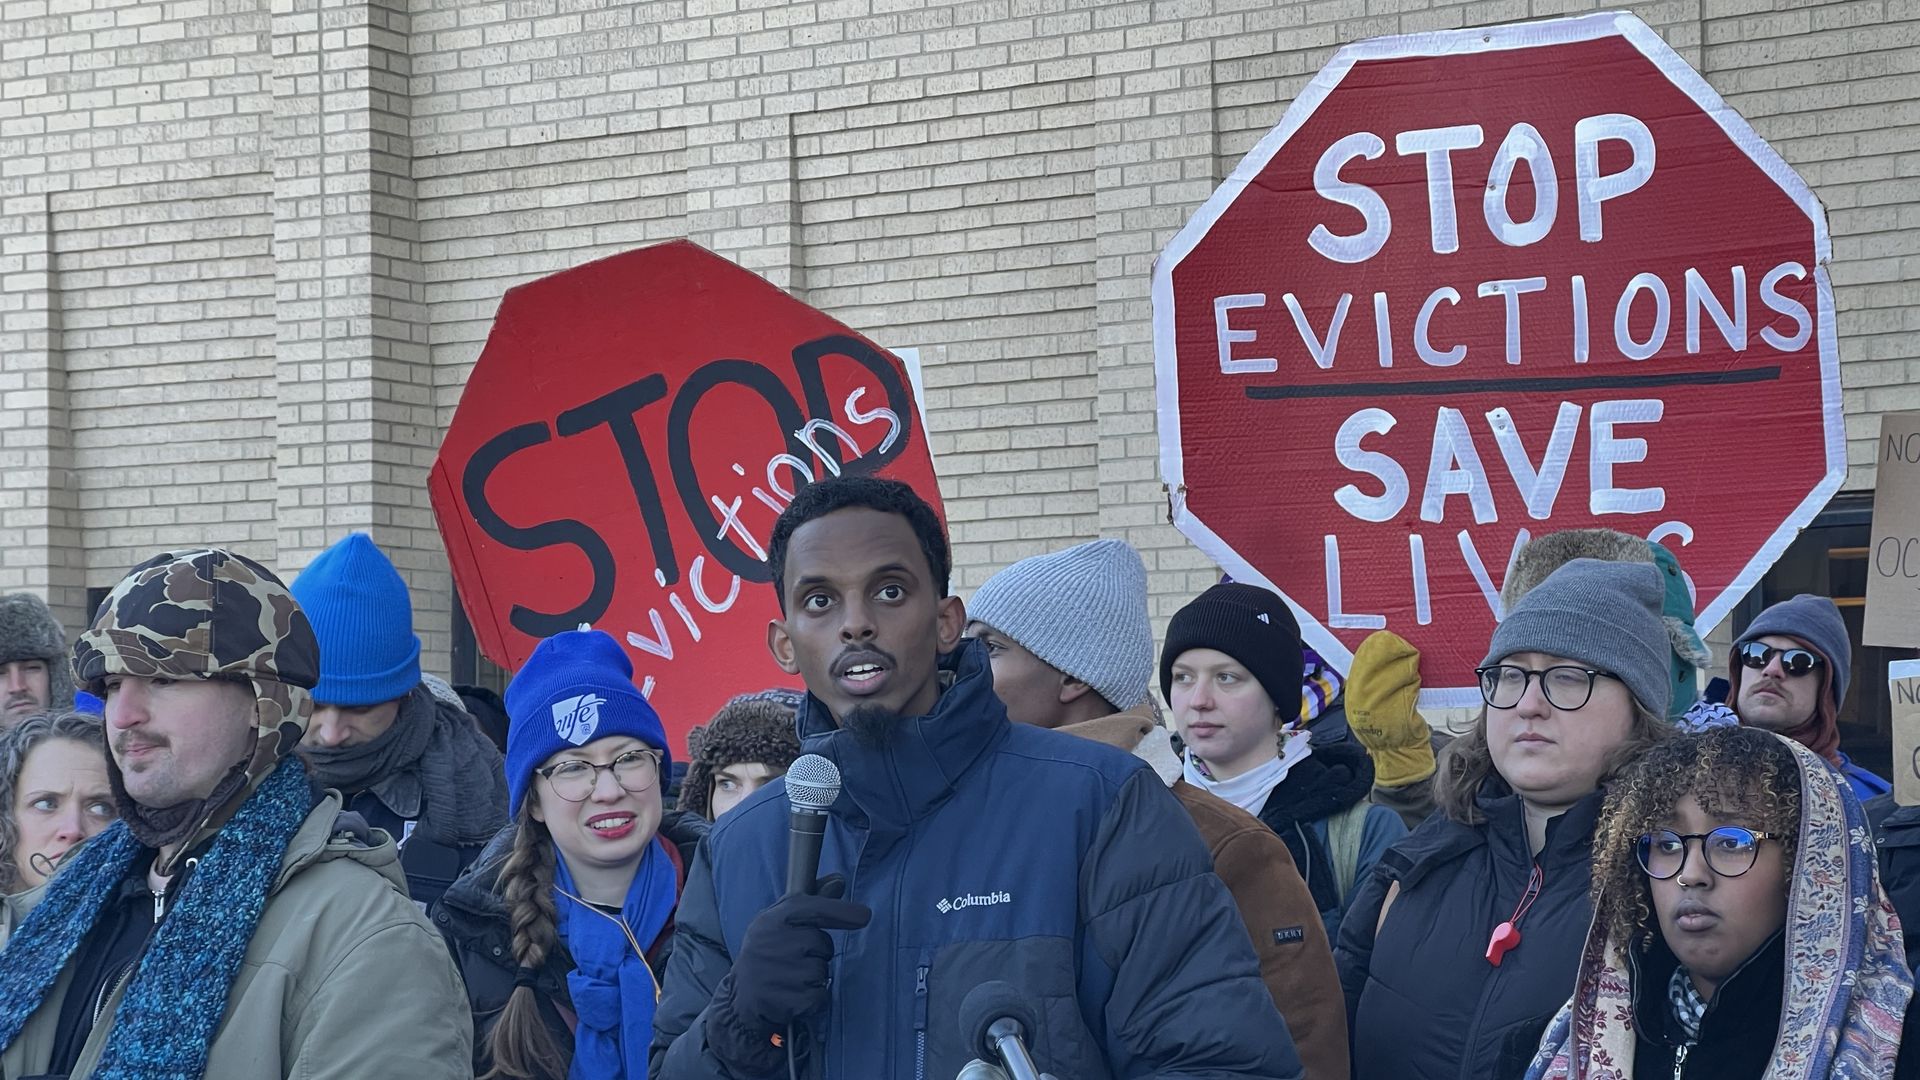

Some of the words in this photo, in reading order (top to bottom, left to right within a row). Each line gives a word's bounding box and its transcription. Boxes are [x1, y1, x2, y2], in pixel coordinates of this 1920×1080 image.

[1307, 113, 1656, 263] STOP
[1213, 262, 1814, 374] EVICTIONS
[462, 335, 912, 639] STOP
[1333, 400, 1666, 524] SAVE
[577, 386, 901, 701] victions
[1324, 521, 1697, 630] LIV
[952, 890, 1011, 911] Columbia
